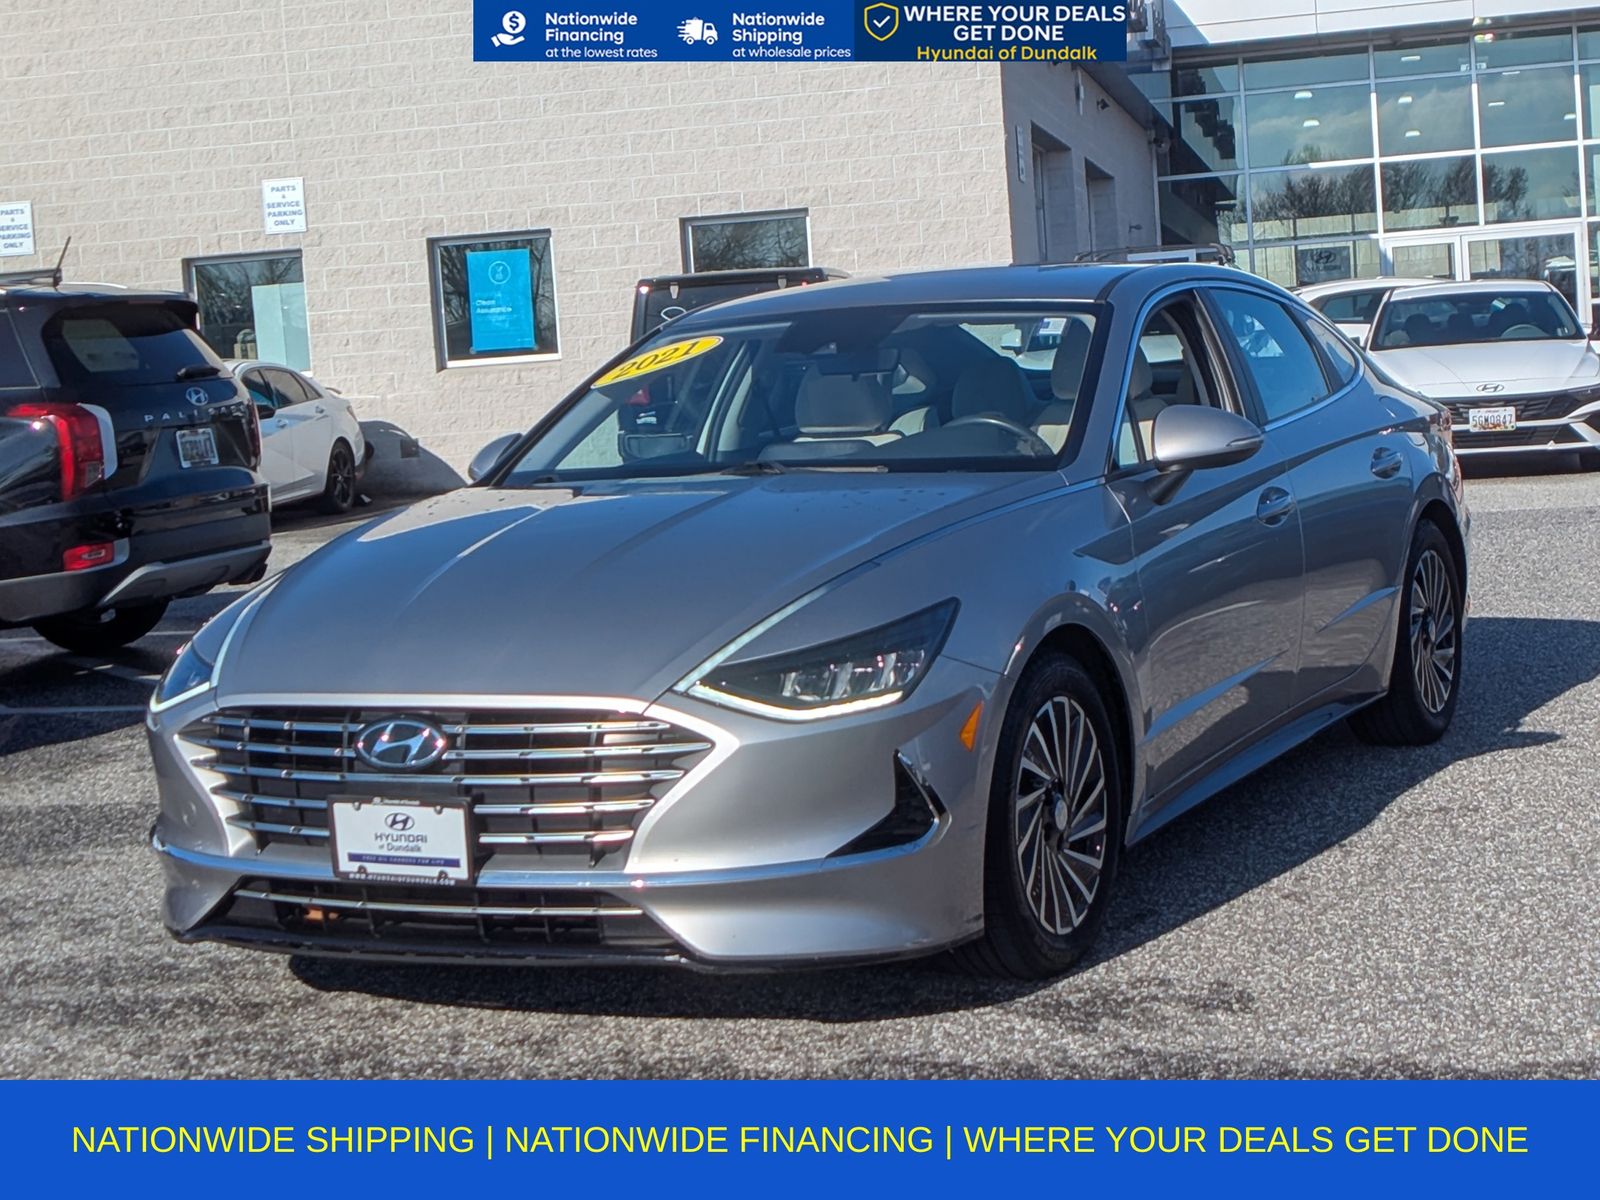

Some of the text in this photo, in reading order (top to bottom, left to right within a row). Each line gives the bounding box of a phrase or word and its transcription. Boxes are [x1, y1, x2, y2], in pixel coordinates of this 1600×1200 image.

[267, 209, 303, 217] PARKING
[611, 341, 700, 379] 2021
[374, 833, 428, 844] HYUNDAI
[387, 843, 422, 853] Dundalk
